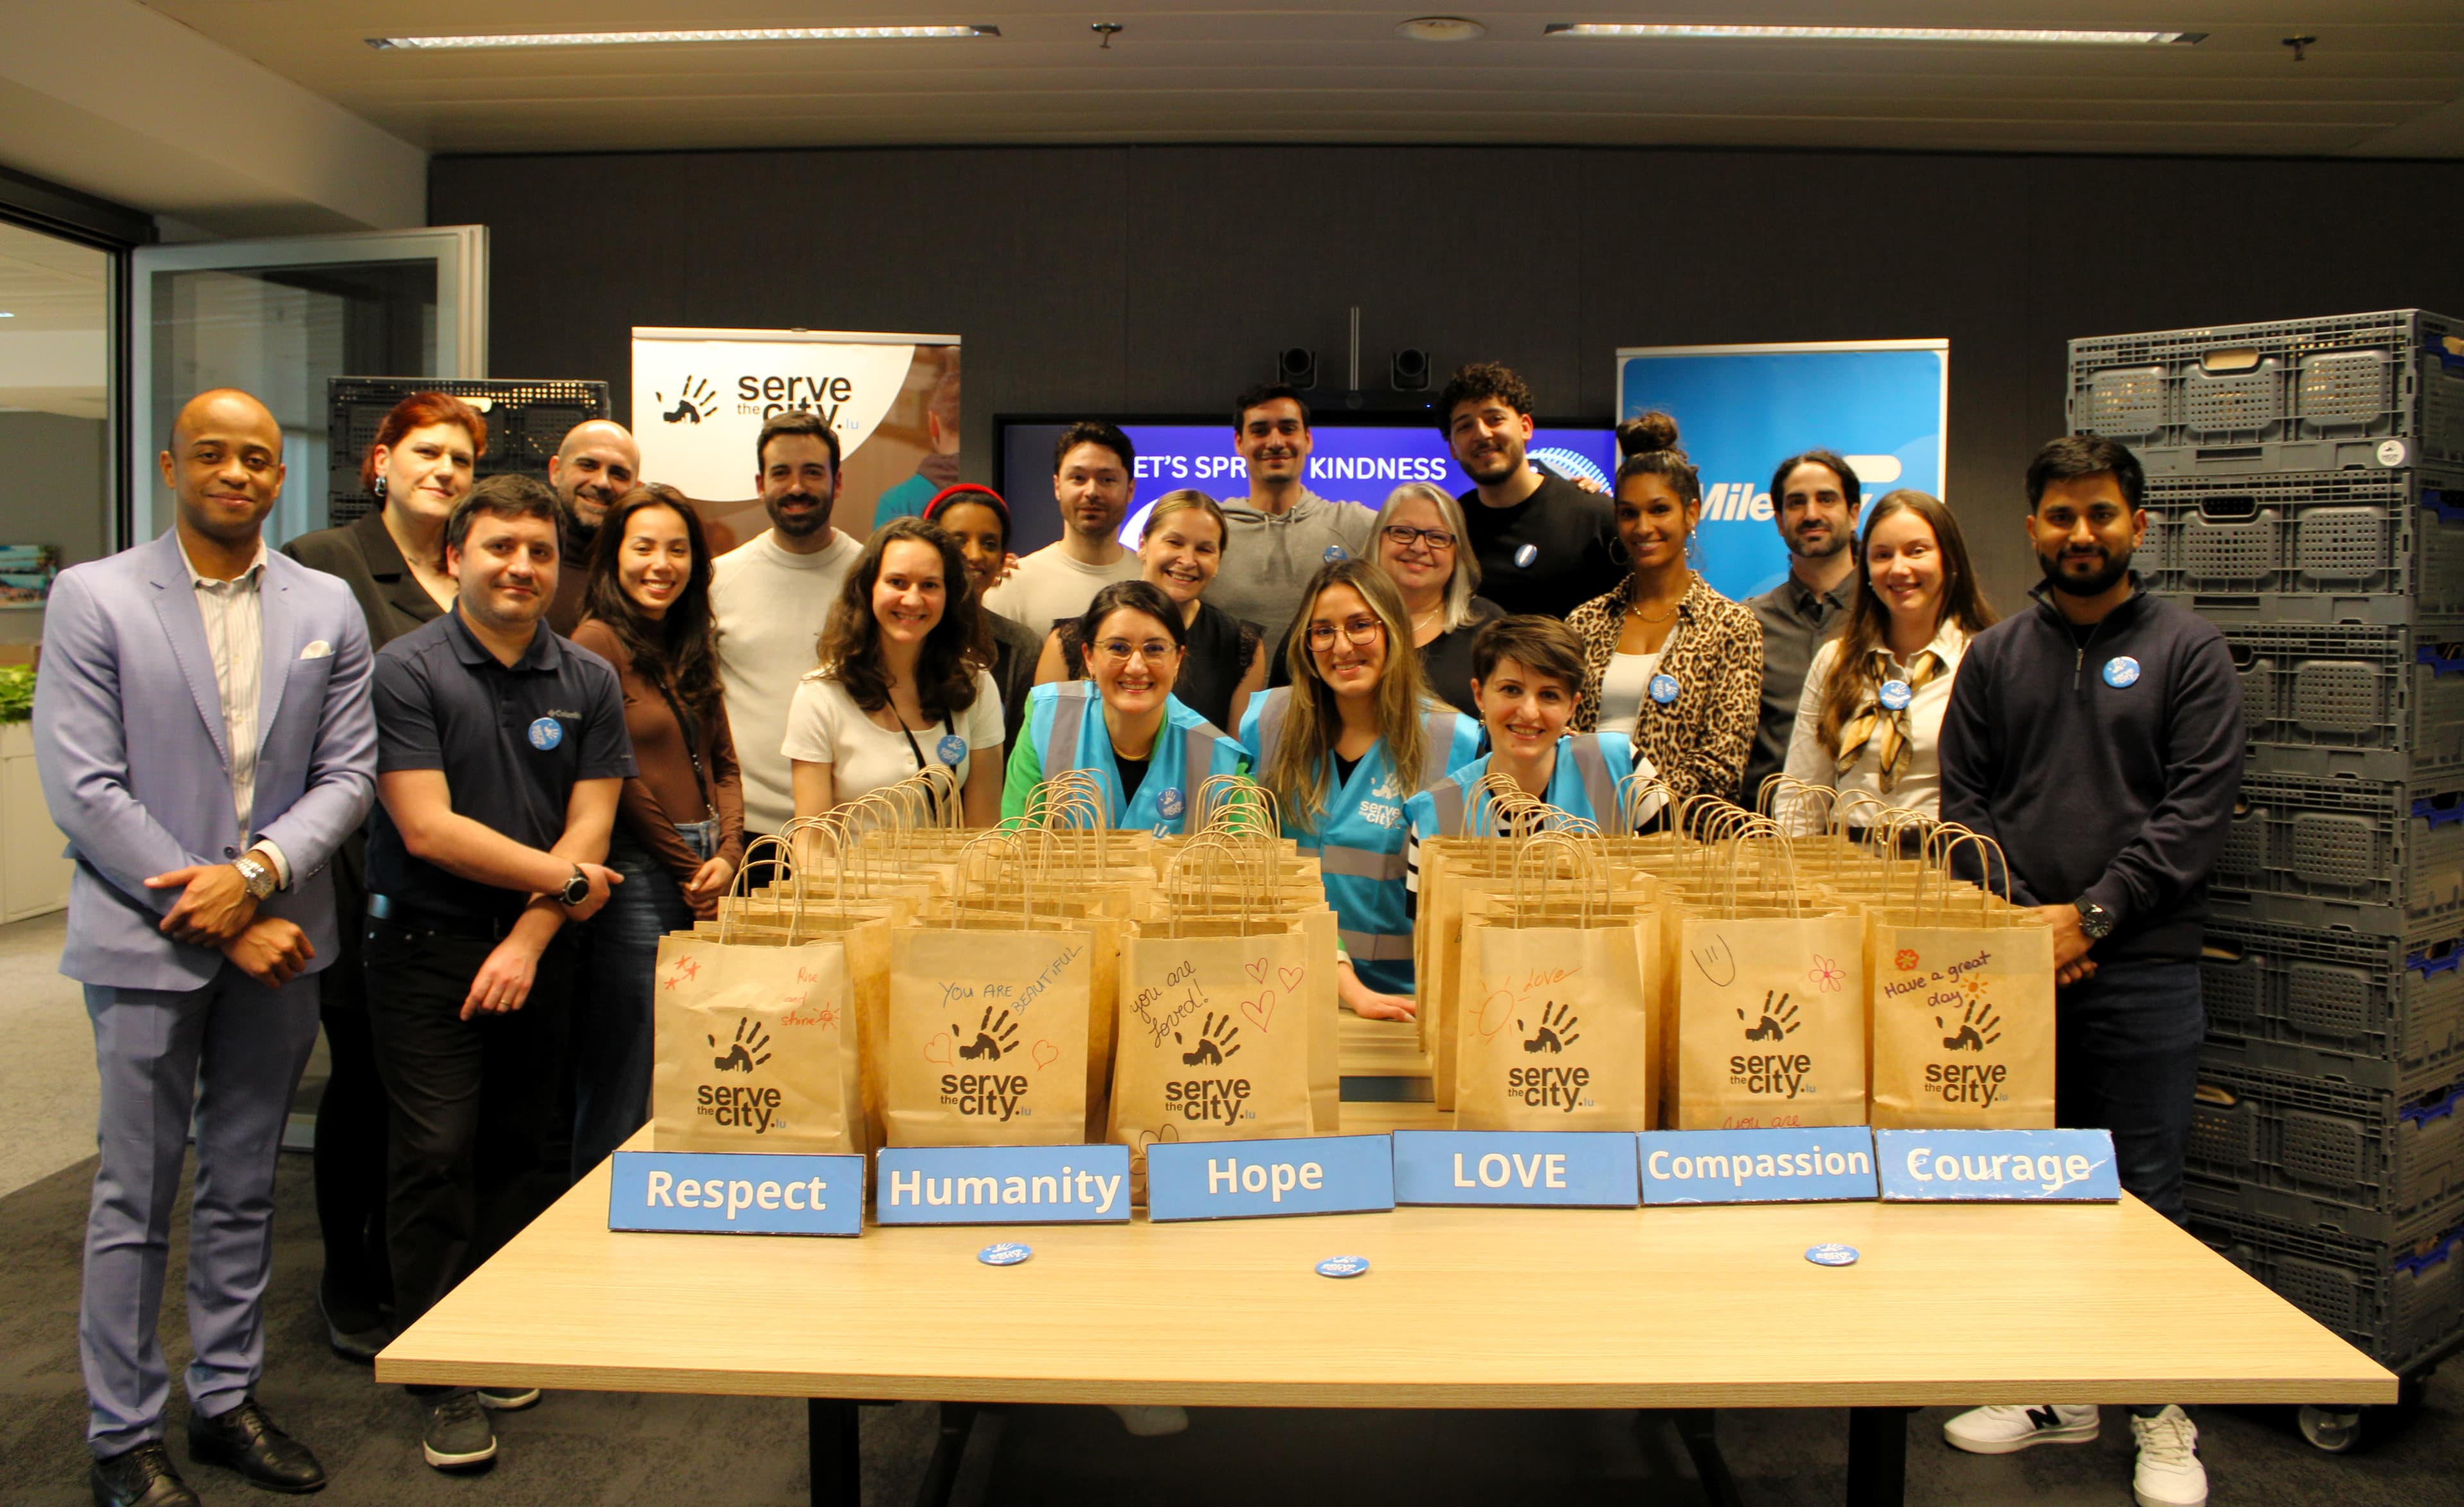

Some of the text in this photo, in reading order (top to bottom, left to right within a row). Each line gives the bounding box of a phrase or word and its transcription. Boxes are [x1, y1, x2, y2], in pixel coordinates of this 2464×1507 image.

[737, 376, 852, 402] serve
[737, 403, 760, 414] the
[1134, 456, 1188, 479] ET'S
[1310, 457, 1447, 481] KINDNESS
[1360, 801, 1401, 819] serve
[1884, 950, 1992, 998] Have a great
[984, 984, 1013, 998] ARE
[1131, 960, 1196, 1024] you are
[1928, 991, 1963, 1008] day
[781, 1010, 815, 1026] shine
[1149, 978, 1209, 1048] loved!
[1730, 1054, 1811, 1075] serve
[1925, 1064, 2007, 1084] serve
[941, 1073, 1029, 1096] serve
[1509, 1066, 1590, 1087] serve
[1730, 1075, 1747, 1085] the
[697, 1084, 782, 1108] serve
[1165, 1078, 1251, 1102] serve
[1508, 1088, 1524, 1097] the
[1925, 1083, 1942, 1093] the
[697, 1105, 714, 1115] the
[941, 1095, 958, 1105] the
[1165, 1102, 1182, 1111] the
[1453, 1153, 1566, 1188] LOVE
[1648, 1146, 1870, 1187] Compassion
[1907, 1148, 2090, 1191] Courage
[890, 1166, 1121, 1214] Humanity
[1208, 1157, 1323, 1202] Hope
[647, 1170, 827, 1220] Respect
